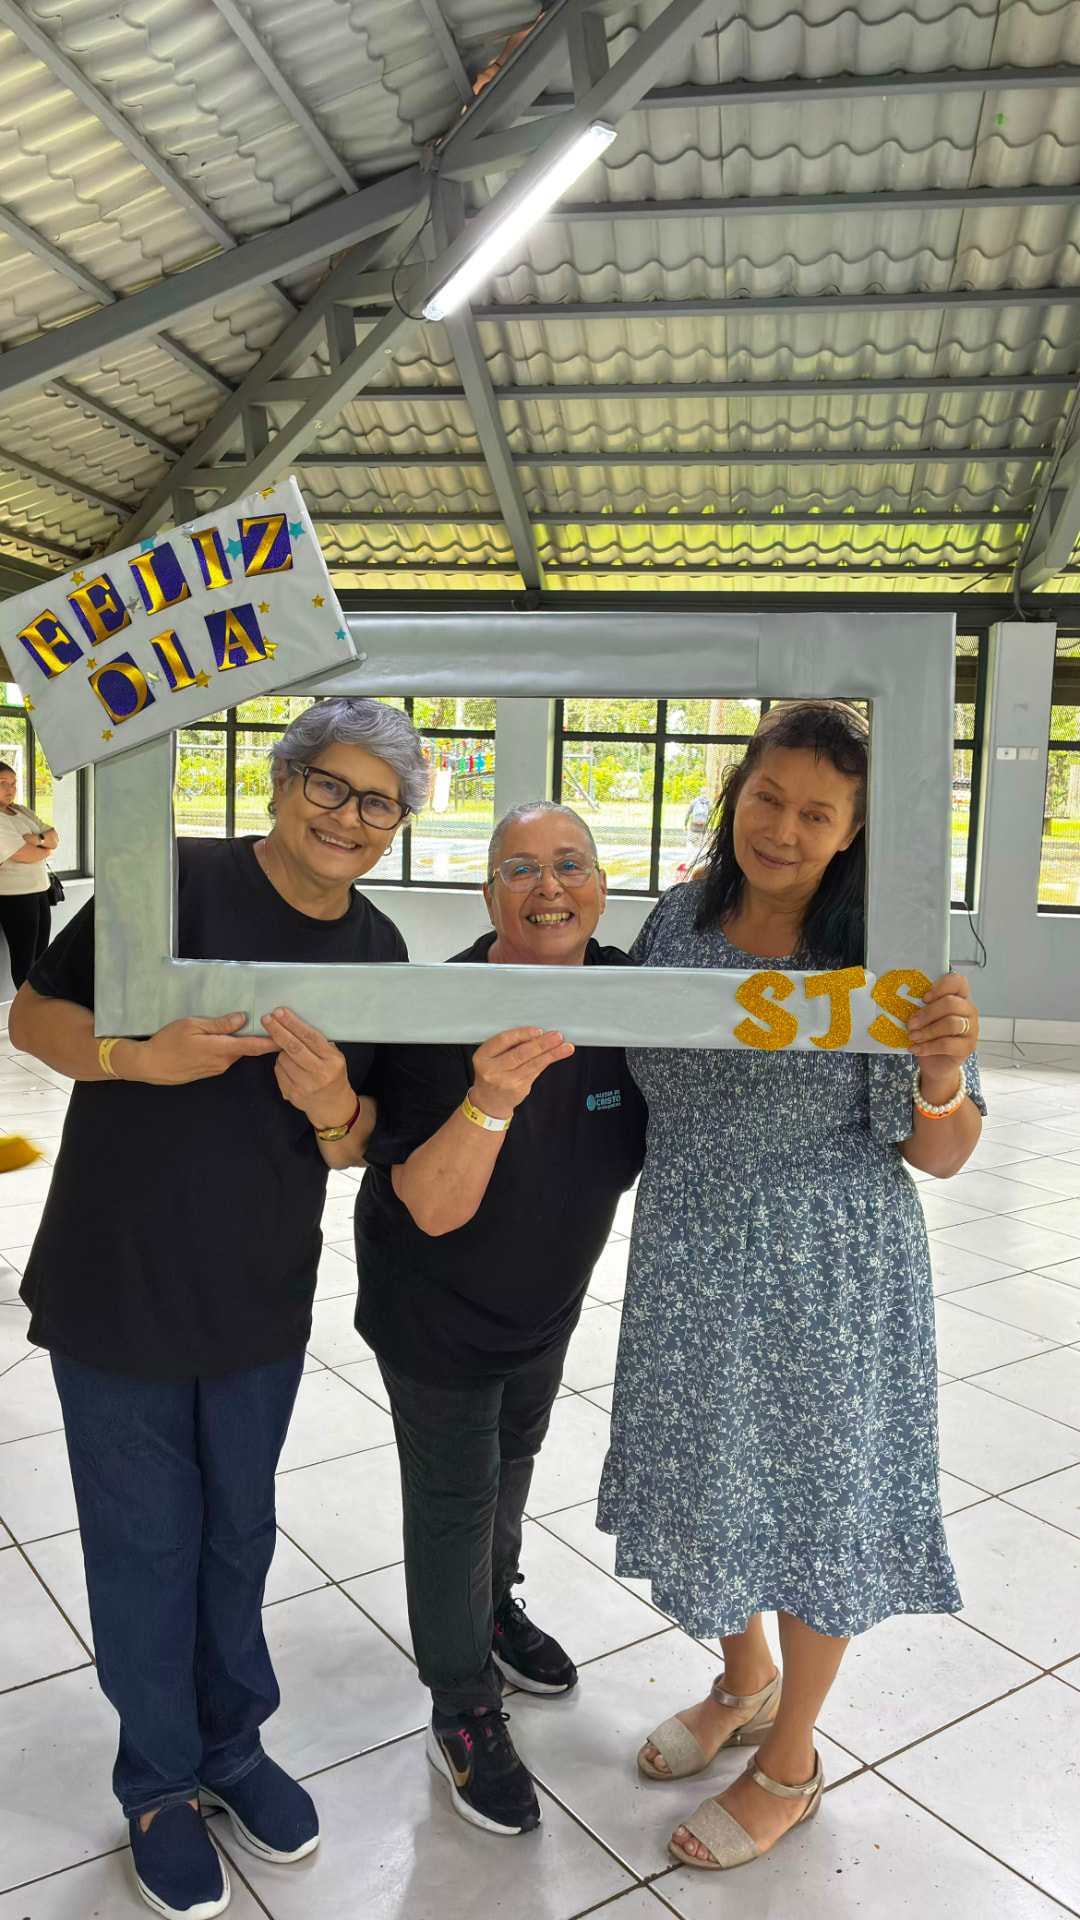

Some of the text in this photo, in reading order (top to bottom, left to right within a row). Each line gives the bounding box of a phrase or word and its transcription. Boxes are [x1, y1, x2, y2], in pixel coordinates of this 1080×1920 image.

[18, 514, 293, 679] FELIZ
[90, 608, 267, 724] DIA
[596, 1095, 621, 1107] CRISTO
